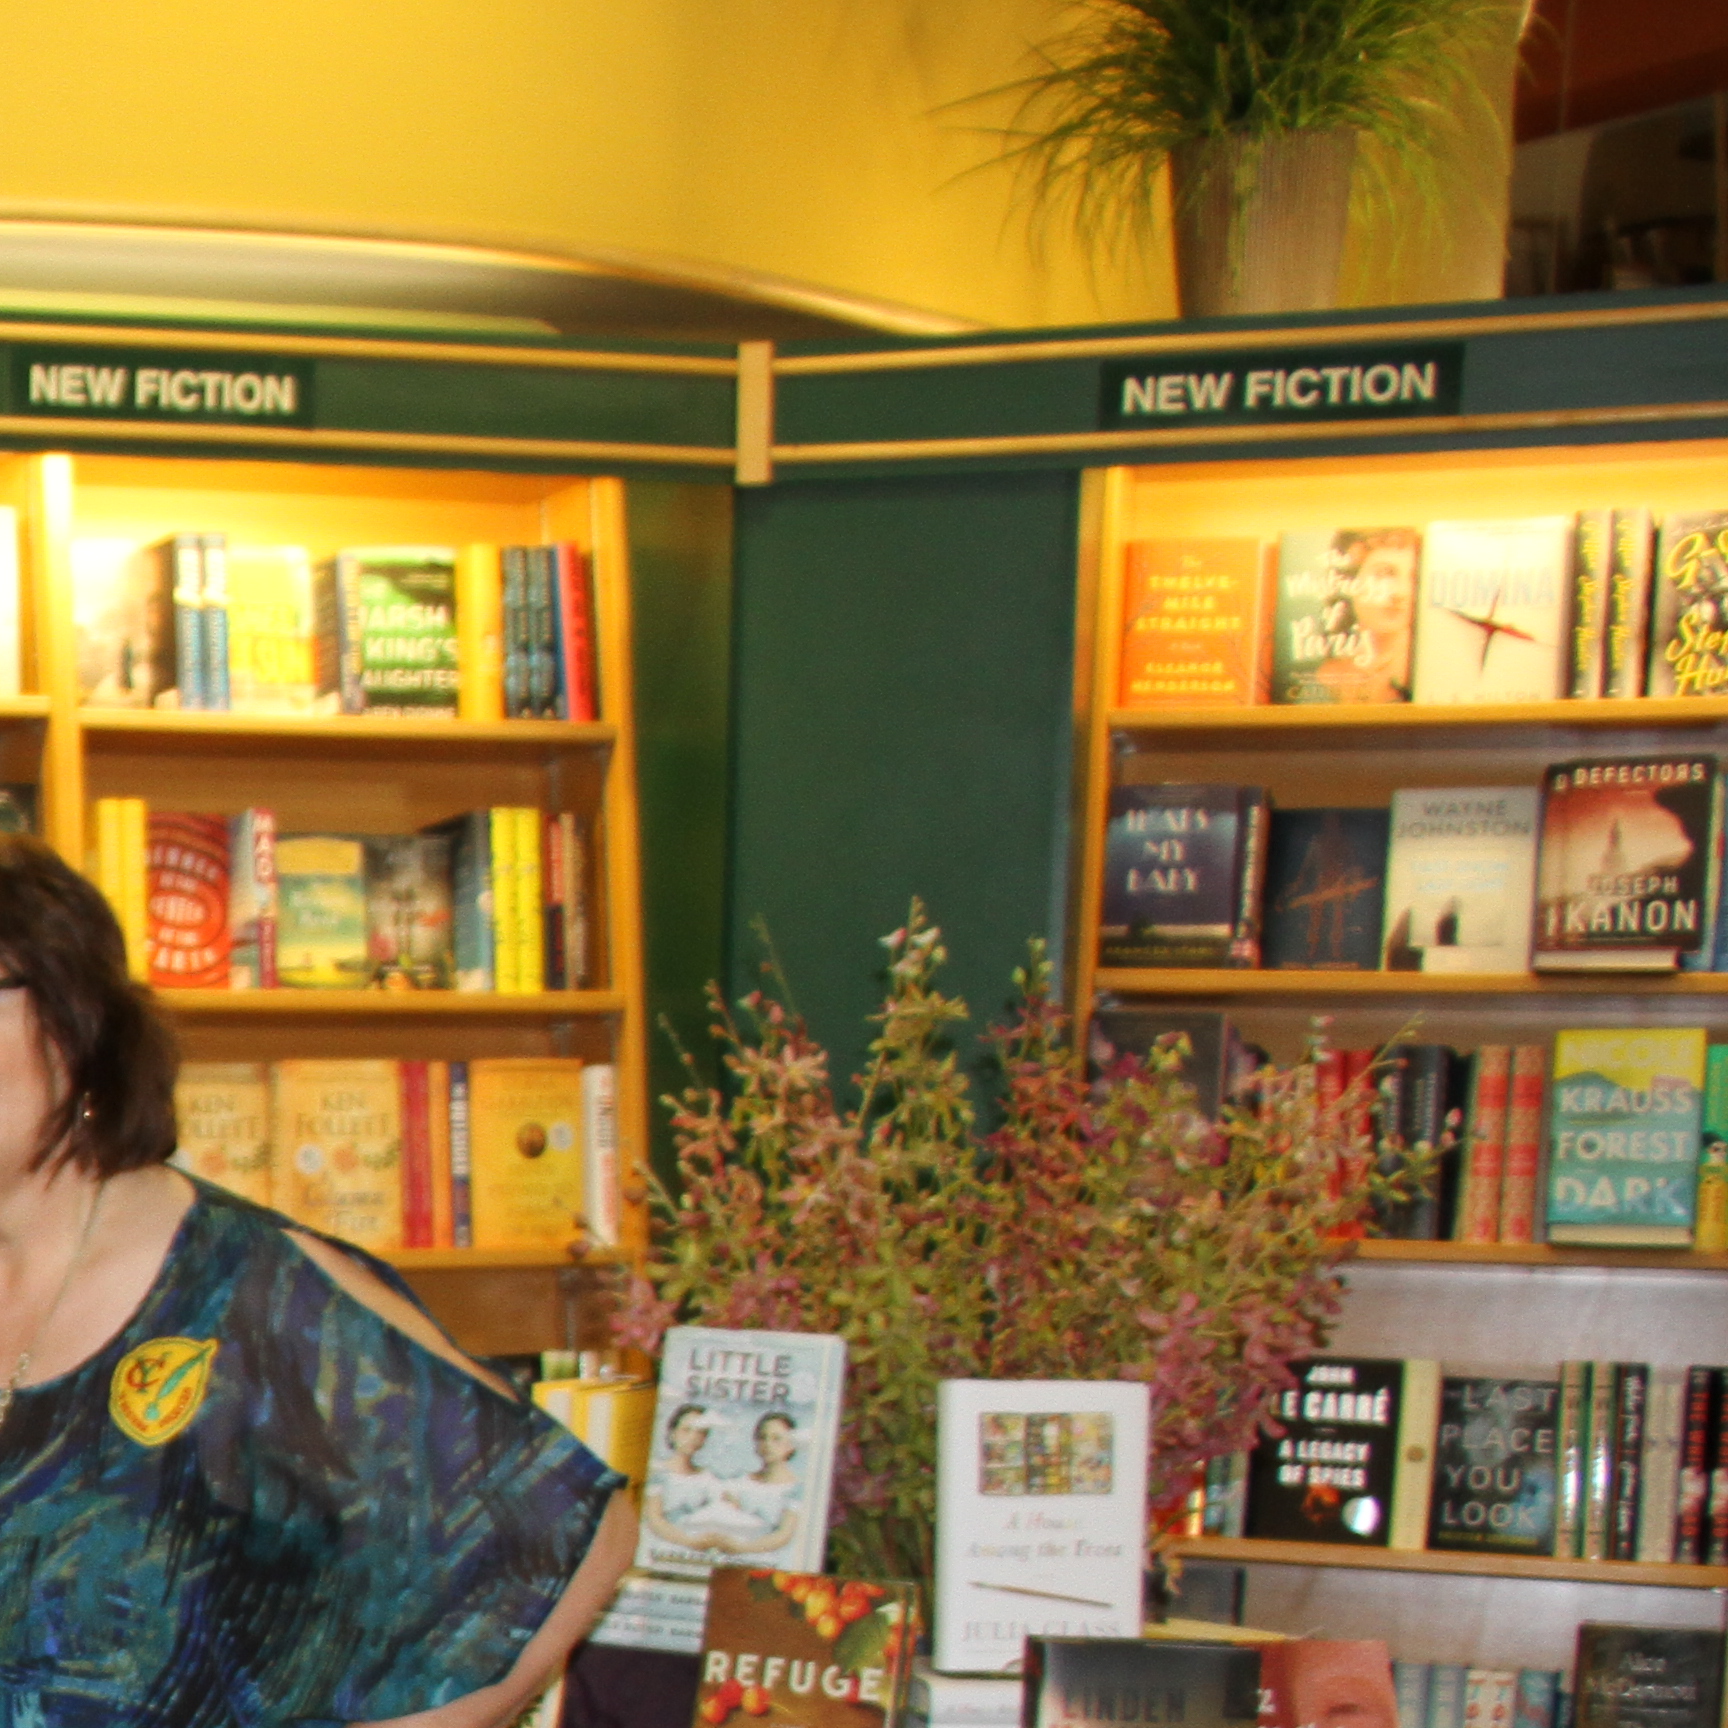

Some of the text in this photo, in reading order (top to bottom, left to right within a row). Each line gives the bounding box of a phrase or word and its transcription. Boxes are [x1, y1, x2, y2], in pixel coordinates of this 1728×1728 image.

[29, 364, 296, 413] NEW FICTION
[1121, 363, 1437, 416] NEW FICTION
[1293, 615, 1374, 667] Paris
[1574, 763, 1707, 787] DEFECTORS
[1423, 801, 1507, 816] WAYNE
[1395, 821, 1531, 839] JOHNSTON
[1588, 874, 1679, 896] JOSEPH
[1566, 899, 1697, 933] KANON
[1560, 1085, 1692, 1115] KRAUSS
[1557, 1131, 1691, 1161] FOREST
[1554, 1175, 1688, 1216] DARK
[688, 1350, 792, 1377] LITTLE
[684, 1375, 791, 1403] SISTER
[1461, 1385, 1559, 1412] LAST
[1303, 1386, 1392, 1426] CARRÉ
[1296, 1440, 1371, 1463] LEGACY
[1442, 1424, 1556, 1454] PLACE
[1277, 1464, 1304, 1486] OF
[1445, 1465, 1523, 1492] YOU
[1443, 1501, 1537, 1528] LOOK
[1037, 1540, 1068, 1558] the
[705, 1650, 885, 1701] REFUGE
[1061, 1687, 1187, 1720] LINDEN
